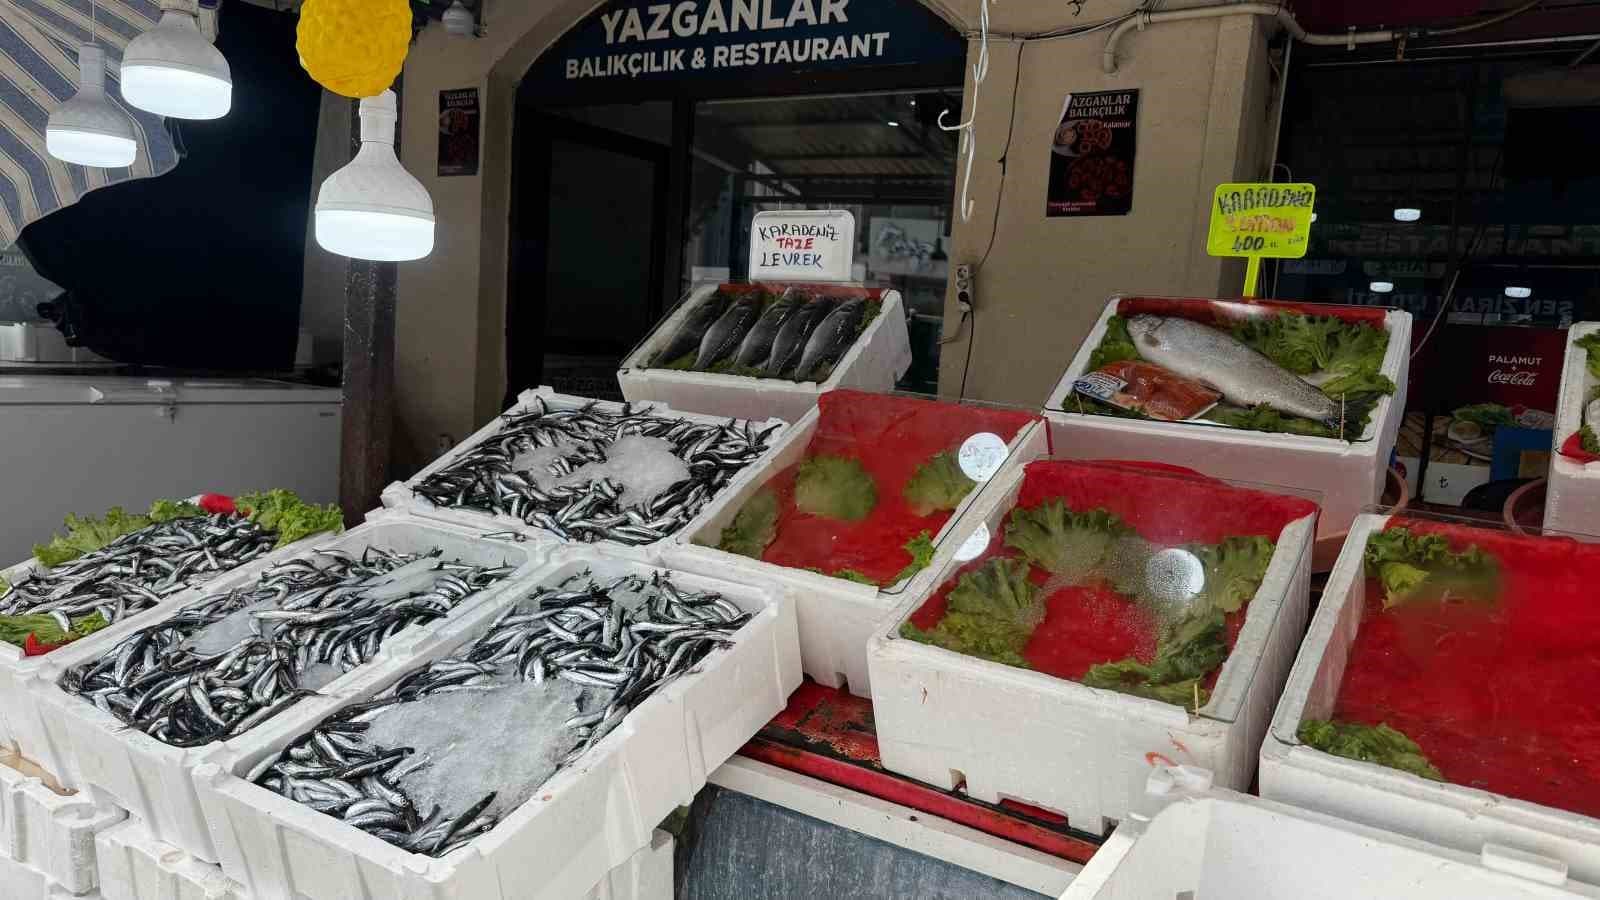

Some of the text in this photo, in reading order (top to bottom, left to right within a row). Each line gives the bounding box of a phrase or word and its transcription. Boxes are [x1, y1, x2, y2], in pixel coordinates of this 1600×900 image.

[601, 0, 849, 44] YAZGANLAR
[566, 31, 890, 79] BALIKÇILIK & RESTAURANT
[1071, 94, 1131, 107] AZGANLAR
[759, 224, 840, 241] KARADENİZ
[776, 238, 814, 249] TAZE
[1231, 235, 1265, 252] 400
[759, 252, 824, 270] LEVREK
[1488, 355, 1543, 366] PALAMUT
